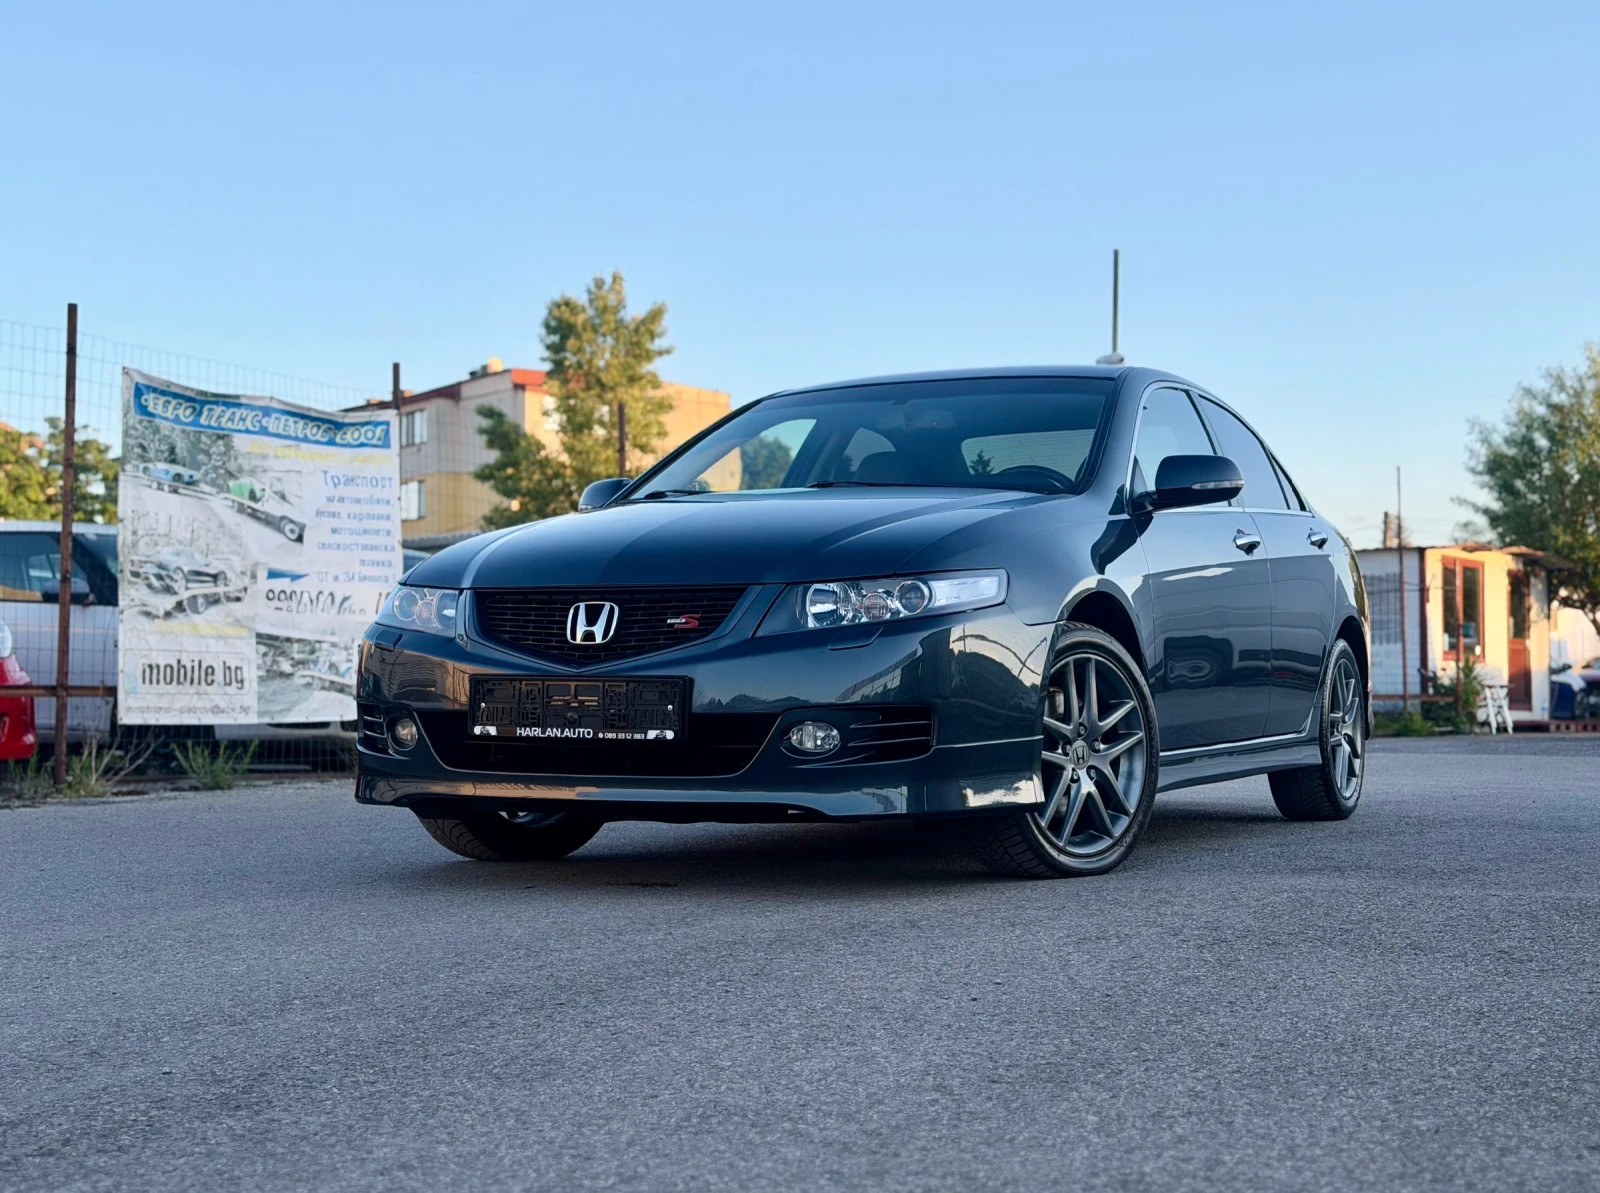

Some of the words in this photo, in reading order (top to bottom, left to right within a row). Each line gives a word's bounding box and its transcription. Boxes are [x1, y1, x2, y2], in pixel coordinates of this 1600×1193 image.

[321, 469, 393, 490] Транспорт
[142, 659, 245, 690] mobile.bg
[516, 727, 593, 738] HARLAN.AUTO
